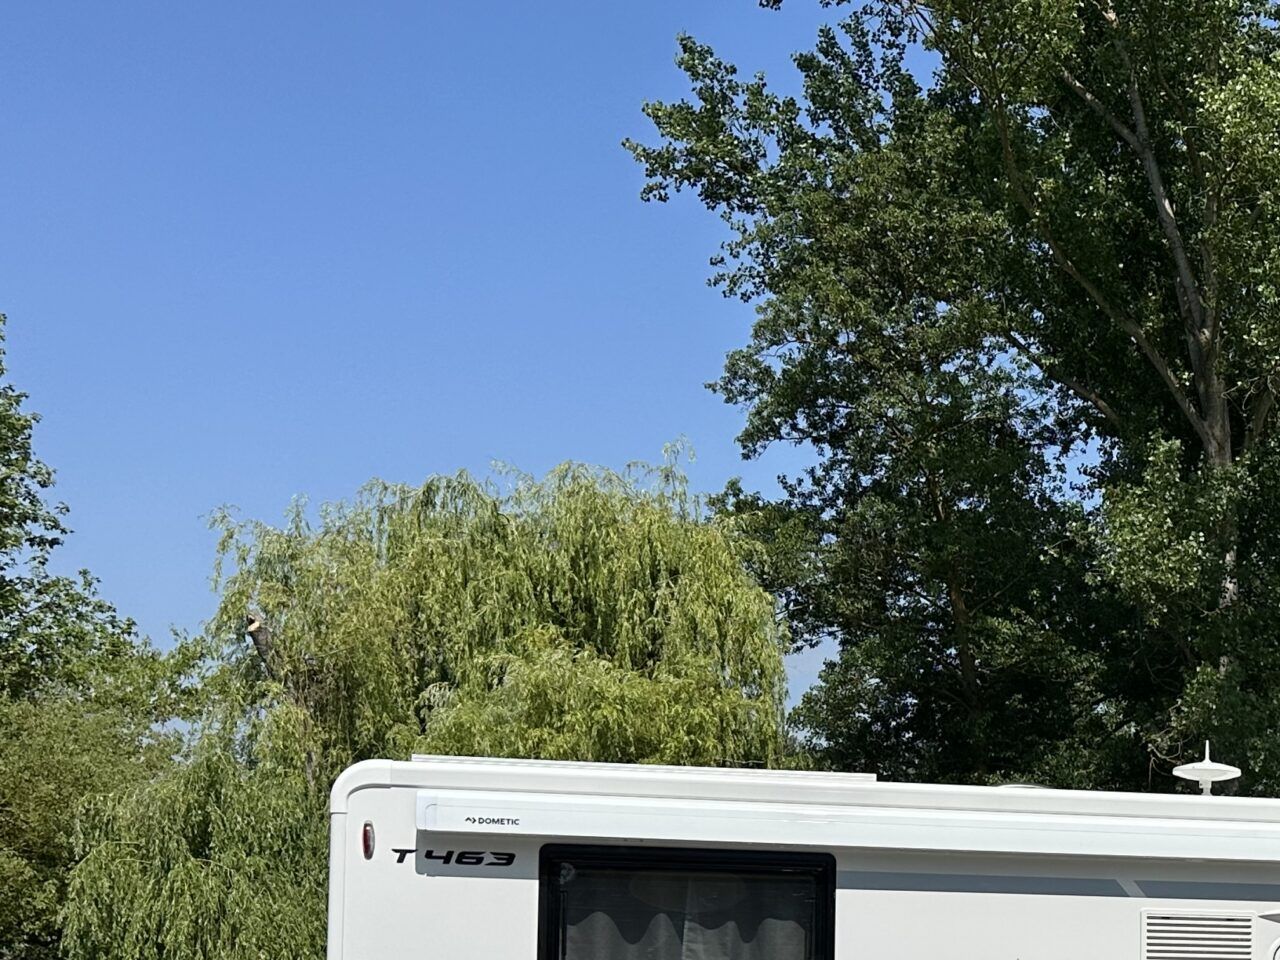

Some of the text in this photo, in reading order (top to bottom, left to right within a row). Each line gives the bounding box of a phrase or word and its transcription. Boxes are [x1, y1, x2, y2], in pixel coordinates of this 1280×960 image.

[478, 817, 520, 826] DOMETIC
[391, 848, 516, 867] T 463
